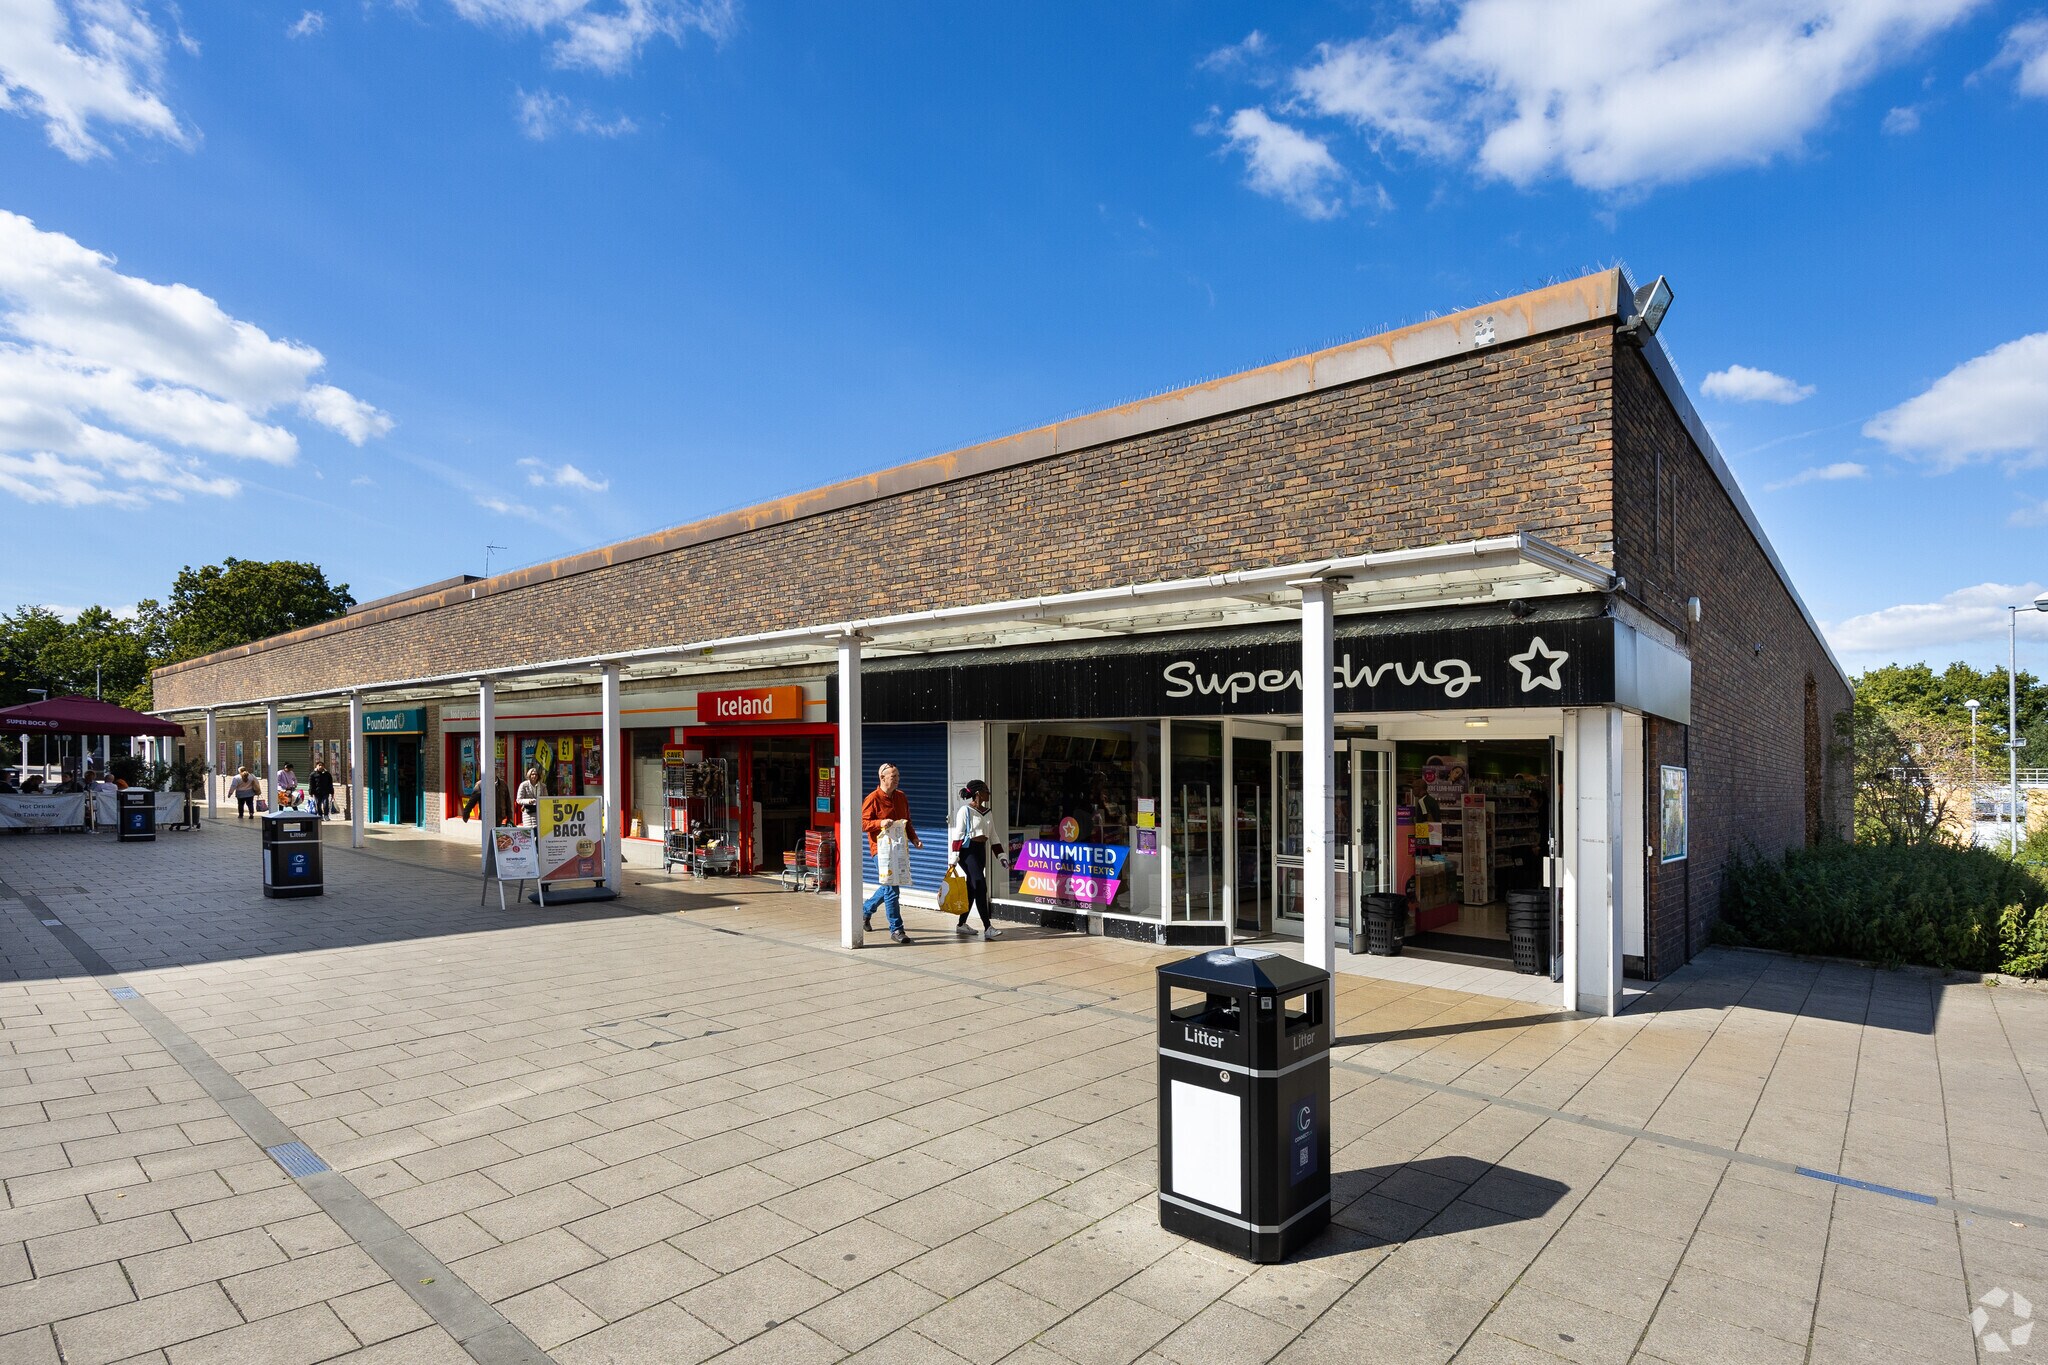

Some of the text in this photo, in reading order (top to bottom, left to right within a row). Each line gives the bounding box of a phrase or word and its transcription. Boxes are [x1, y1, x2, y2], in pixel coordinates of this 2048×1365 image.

[717, 694, 773, 717] Iceland
[366, 716, 398, 731] Poundland
[561, 741, 570, 755] £1
[666, 751, 682, 759] SAVE
[553, 803, 585, 822] 5%
[553, 823, 587, 837] BACK
[1028, 842, 1117, 865] UNLIMITED
[1028, 860, 1048, 869] DATA
[1055, 863, 1081, 873] CALLS
[1088, 865, 1115, 876] TEXTS
[1027, 876, 1059, 892] ONLY
[1064, 877, 1099, 899] £20
[1034, 896, 1046, 904] GET
[1184, 1026, 1225, 1050] Litter
[1292, 1032, 1316, 1052] Litter
